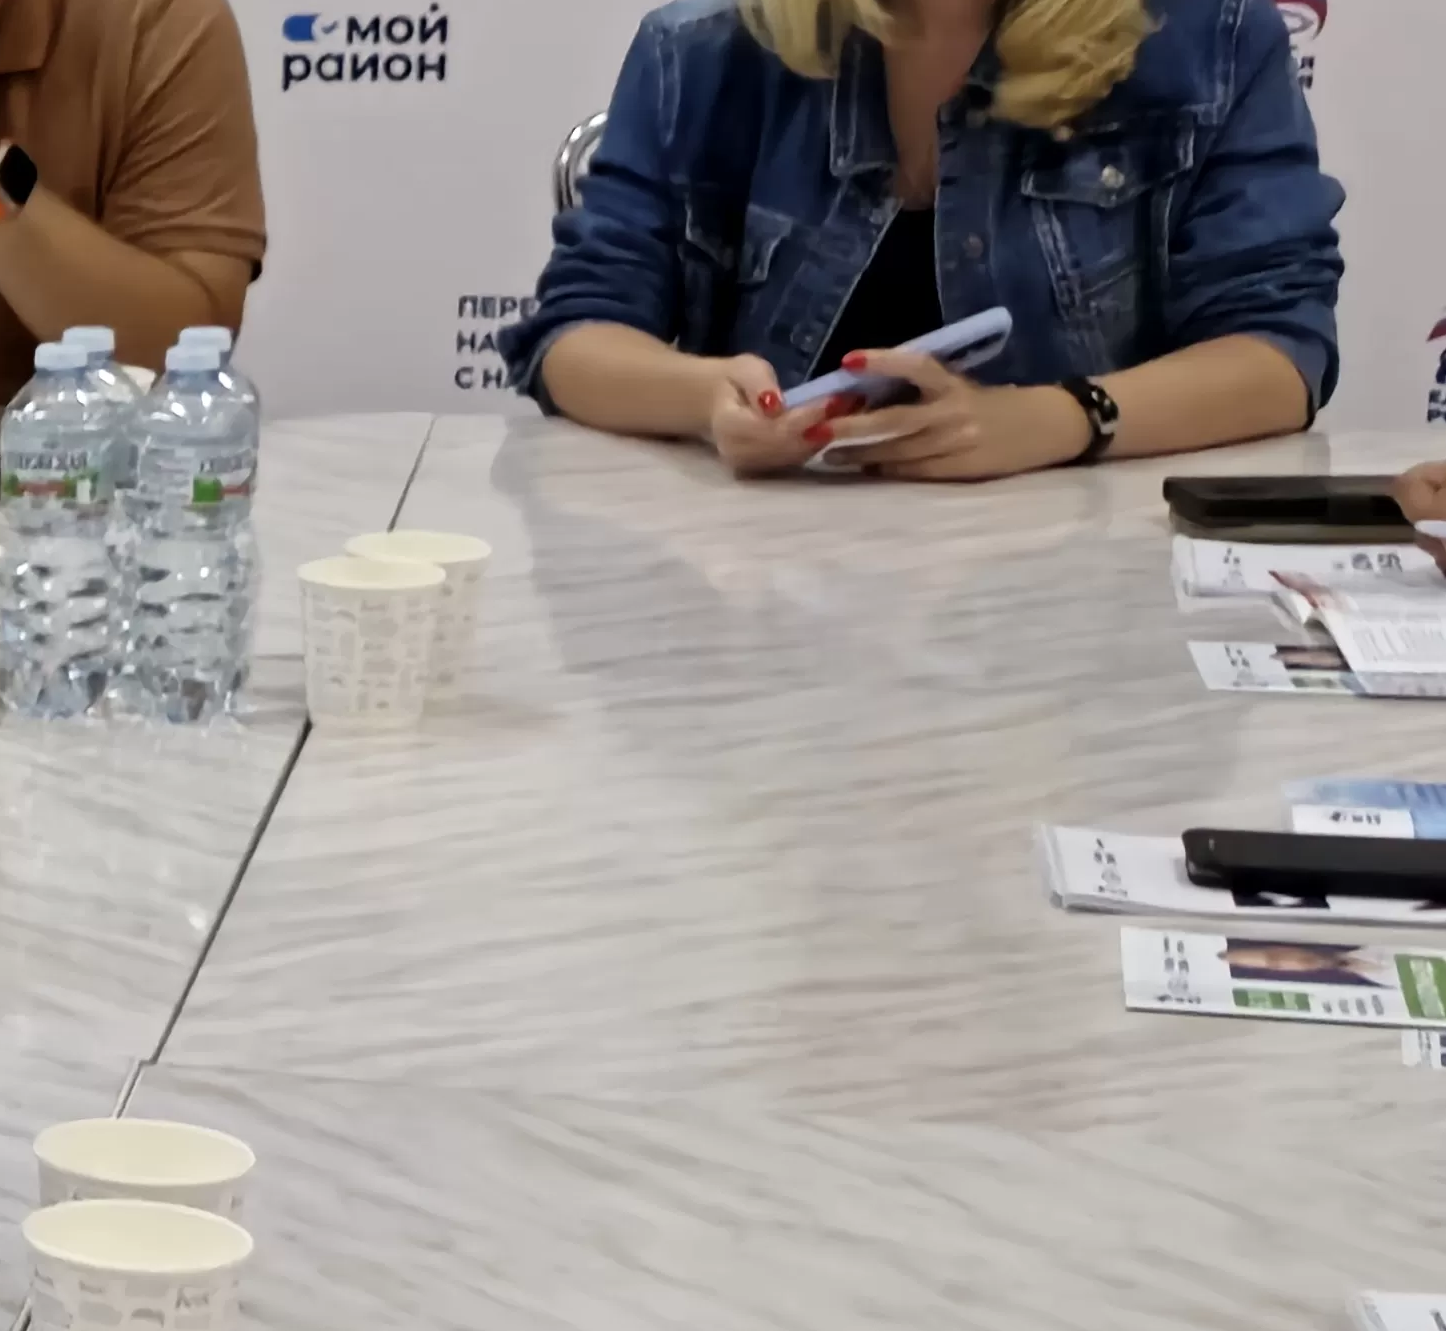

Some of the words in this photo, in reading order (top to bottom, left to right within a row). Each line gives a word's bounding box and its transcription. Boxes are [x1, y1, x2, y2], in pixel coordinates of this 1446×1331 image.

[346, 2, 449, 47] мой
[281, 50, 448, 91] район
[457, 295, 540, 319] ПЕРЕ
